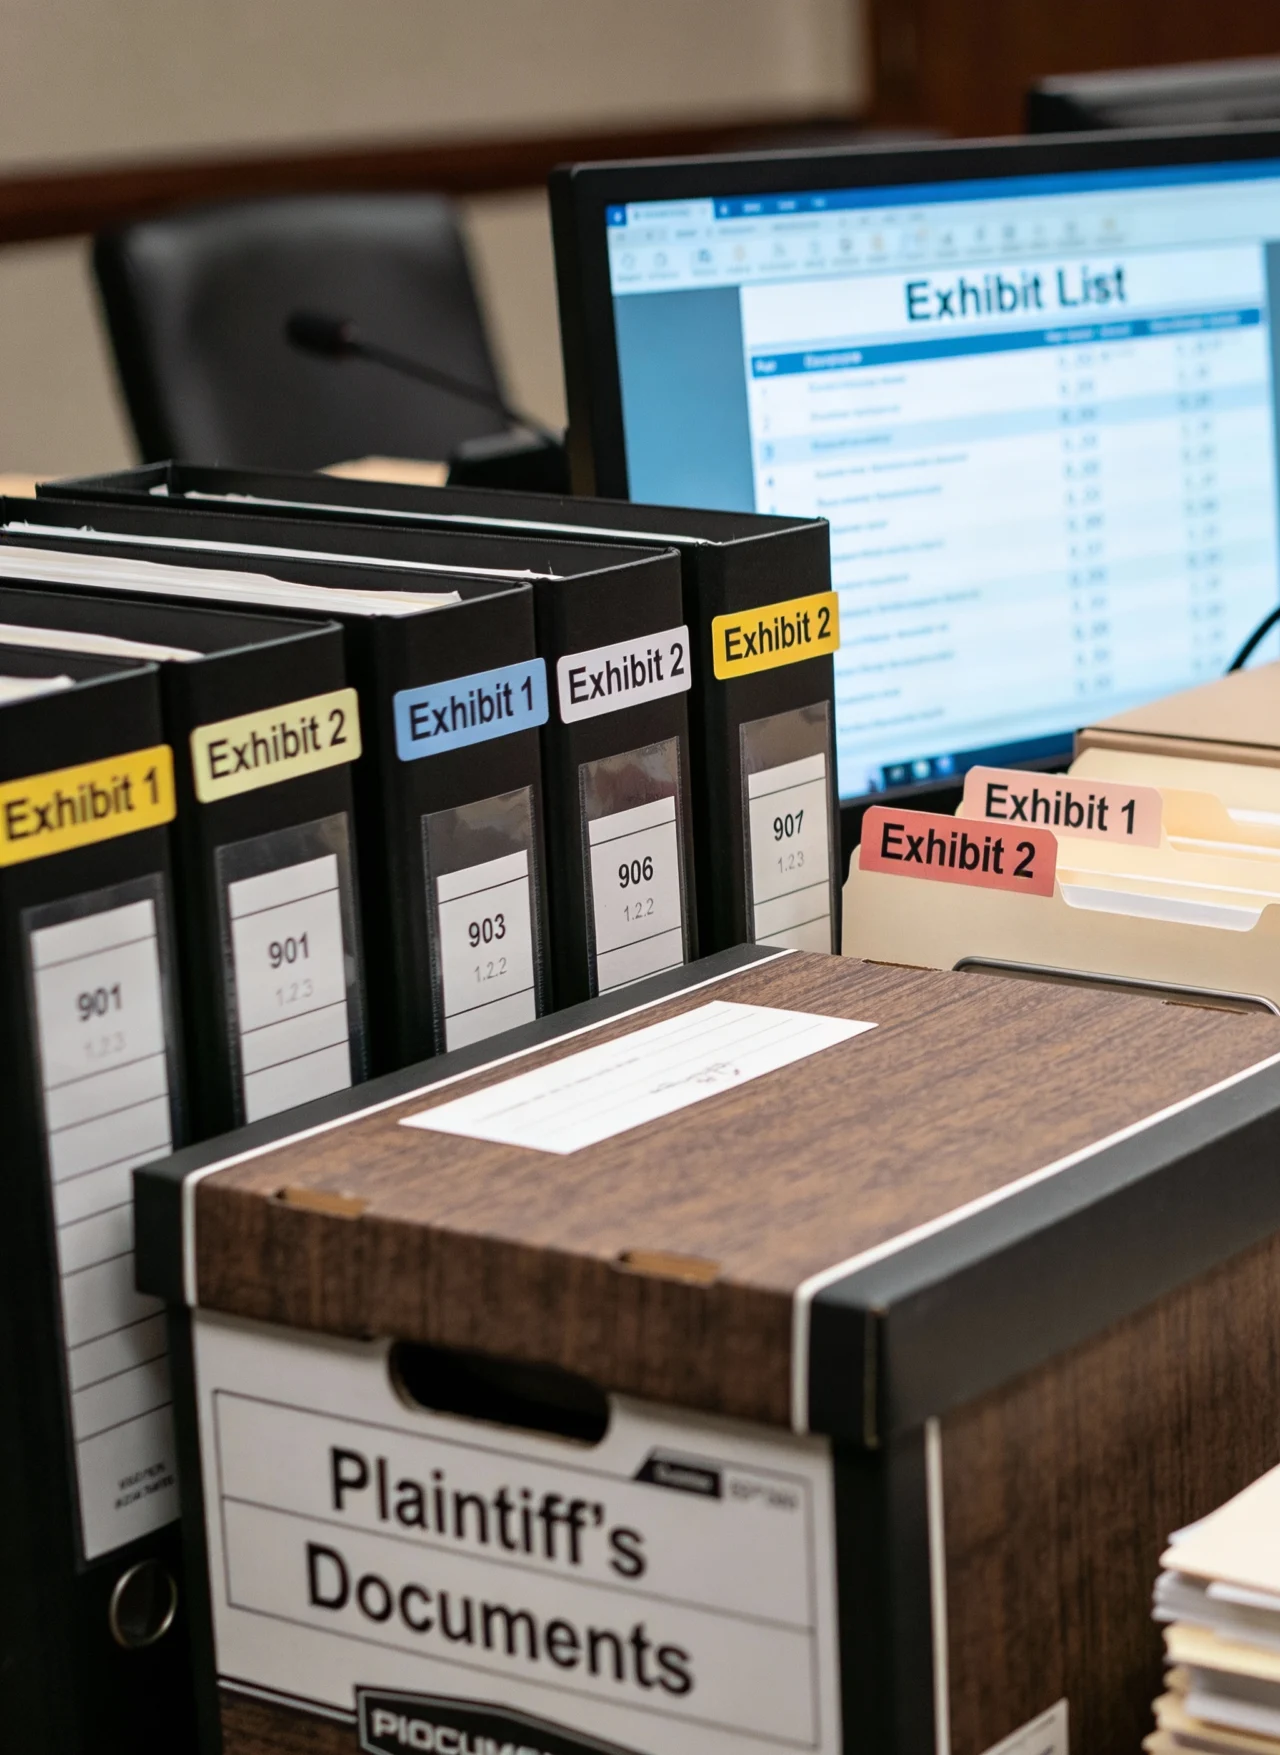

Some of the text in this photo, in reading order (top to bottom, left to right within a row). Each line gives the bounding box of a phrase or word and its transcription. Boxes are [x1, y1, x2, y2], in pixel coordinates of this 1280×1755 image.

[906, 265, 1125, 321] Exhibit List
[724, 606, 832, 663] Exhibit 2
[568, 642, 685, 705] Exhibit 2
[409, 675, 533, 742] Exhibit 1
[207, 708, 348, 780] Exhibit 2
[4, 765, 160, 842] Exhibit 1
[984, 782, 1136, 835] Exhibit 1
[618, 855, 654, 889] 906
[880, 821, 1036, 879] Exhibit 2
[468, 912, 506, 948] 903
[623, 897, 654, 922] 1.2.2
[268, 931, 310, 970] 901
[473, 956, 508, 983] 1.2.2
[76, 981, 122, 1022] 901
[330, 1445, 648, 1579] Plaintiff's
[305, 1540, 694, 1696] Documents
